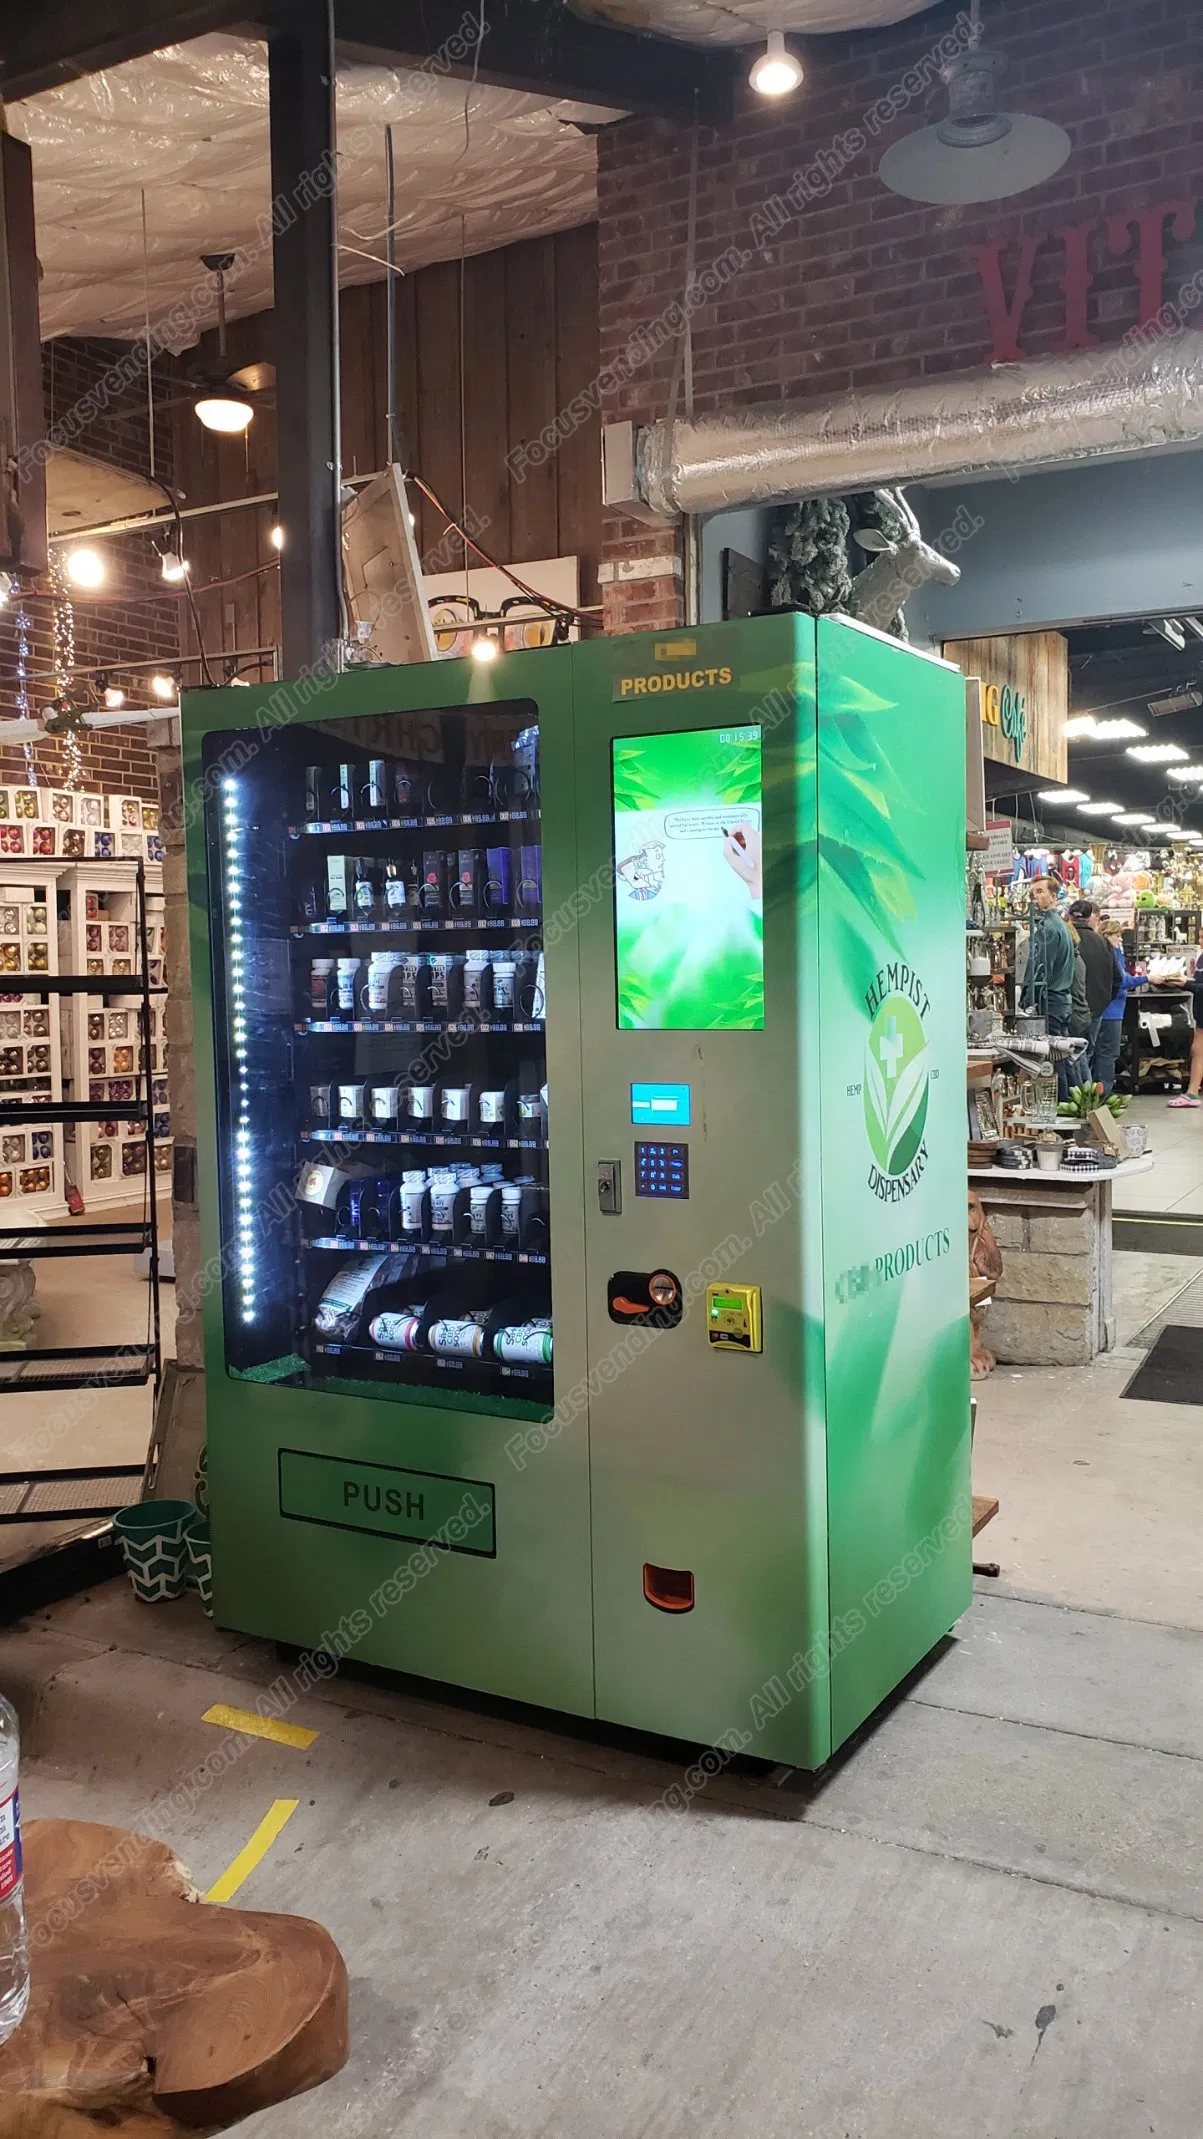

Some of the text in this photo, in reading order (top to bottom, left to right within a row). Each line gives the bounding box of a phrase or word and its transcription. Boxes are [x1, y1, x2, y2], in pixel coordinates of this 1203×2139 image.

[620, 667, 733, 696] PRODUCTS
[864, 961, 931, 1021] HEMPIST
[846, 1084, 862, 1097] HEMP
[867, 1137, 929, 1203] DISPENSARY
[875, 1227, 951, 1282] PRODUCTS
[343, 1481, 426, 1522] PUSH
